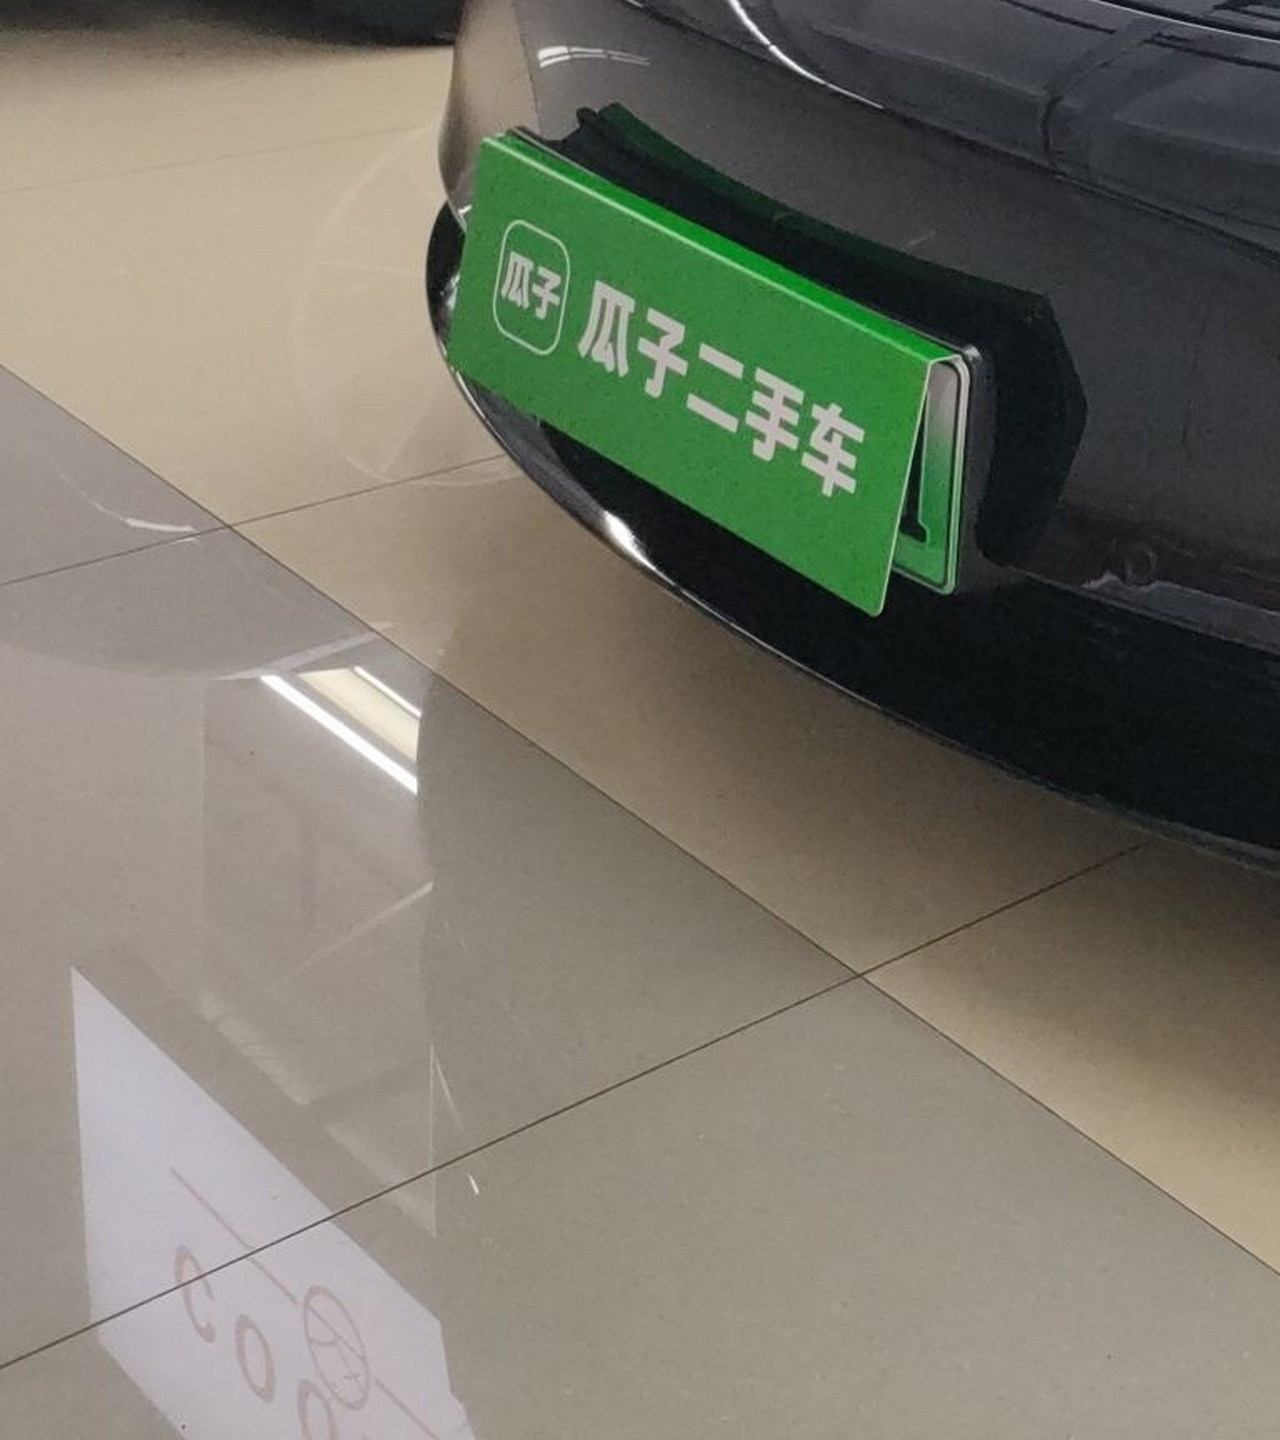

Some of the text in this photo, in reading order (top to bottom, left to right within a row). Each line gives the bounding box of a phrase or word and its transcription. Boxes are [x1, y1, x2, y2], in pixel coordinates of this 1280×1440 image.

[500, 251, 562, 320] 瓜子
[577, 280, 866, 498] 瓜子二手车
